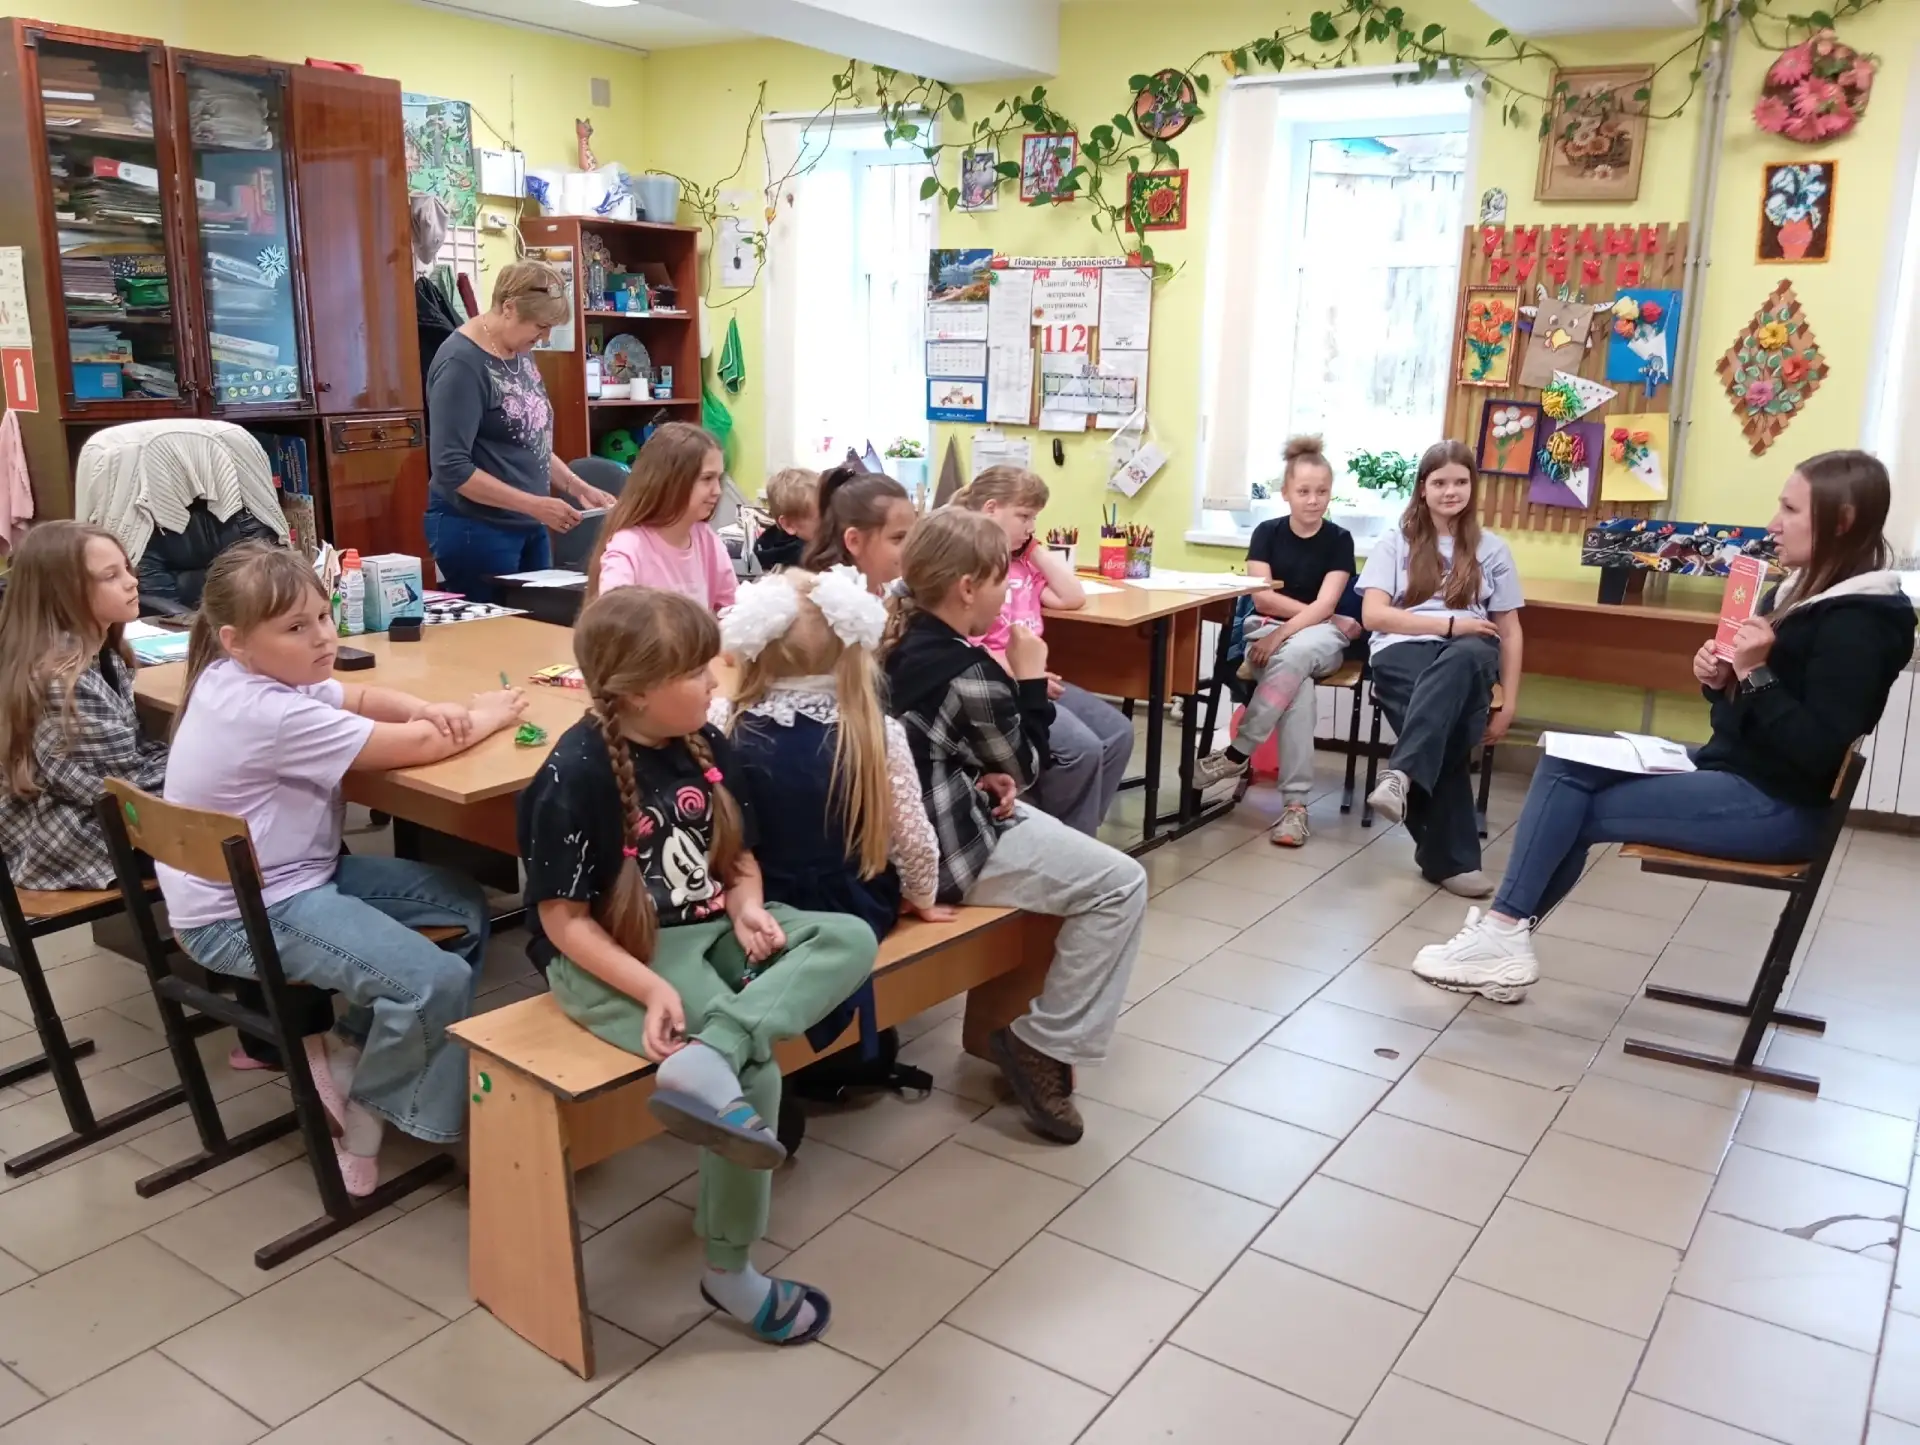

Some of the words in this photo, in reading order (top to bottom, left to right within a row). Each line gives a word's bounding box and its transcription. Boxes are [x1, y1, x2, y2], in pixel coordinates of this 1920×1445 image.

[1014, 257, 1056, 268] Пожарная
[1061, 258, 1123, 267] безопасность
[1042, 324, 1086, 353] 112
